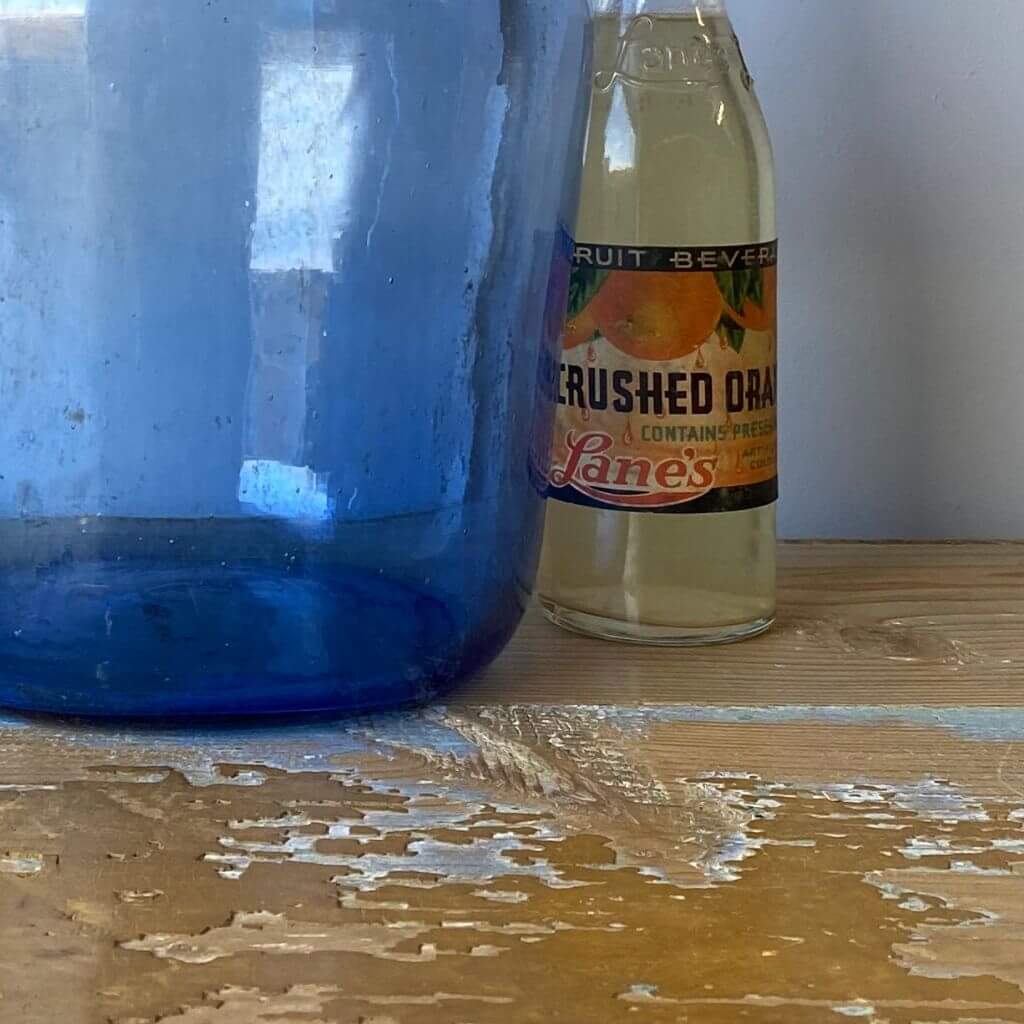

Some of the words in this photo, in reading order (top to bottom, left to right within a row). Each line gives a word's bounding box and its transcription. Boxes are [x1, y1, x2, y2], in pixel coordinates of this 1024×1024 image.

[573, 246, 647, 268] RUIT
[555, 363, 713, 416] CRUSHED
[725, 366, 776, 413] ORA
[640, 424, 727, 442] CONTAINS
[549, 430, 718, 507] Lane's
